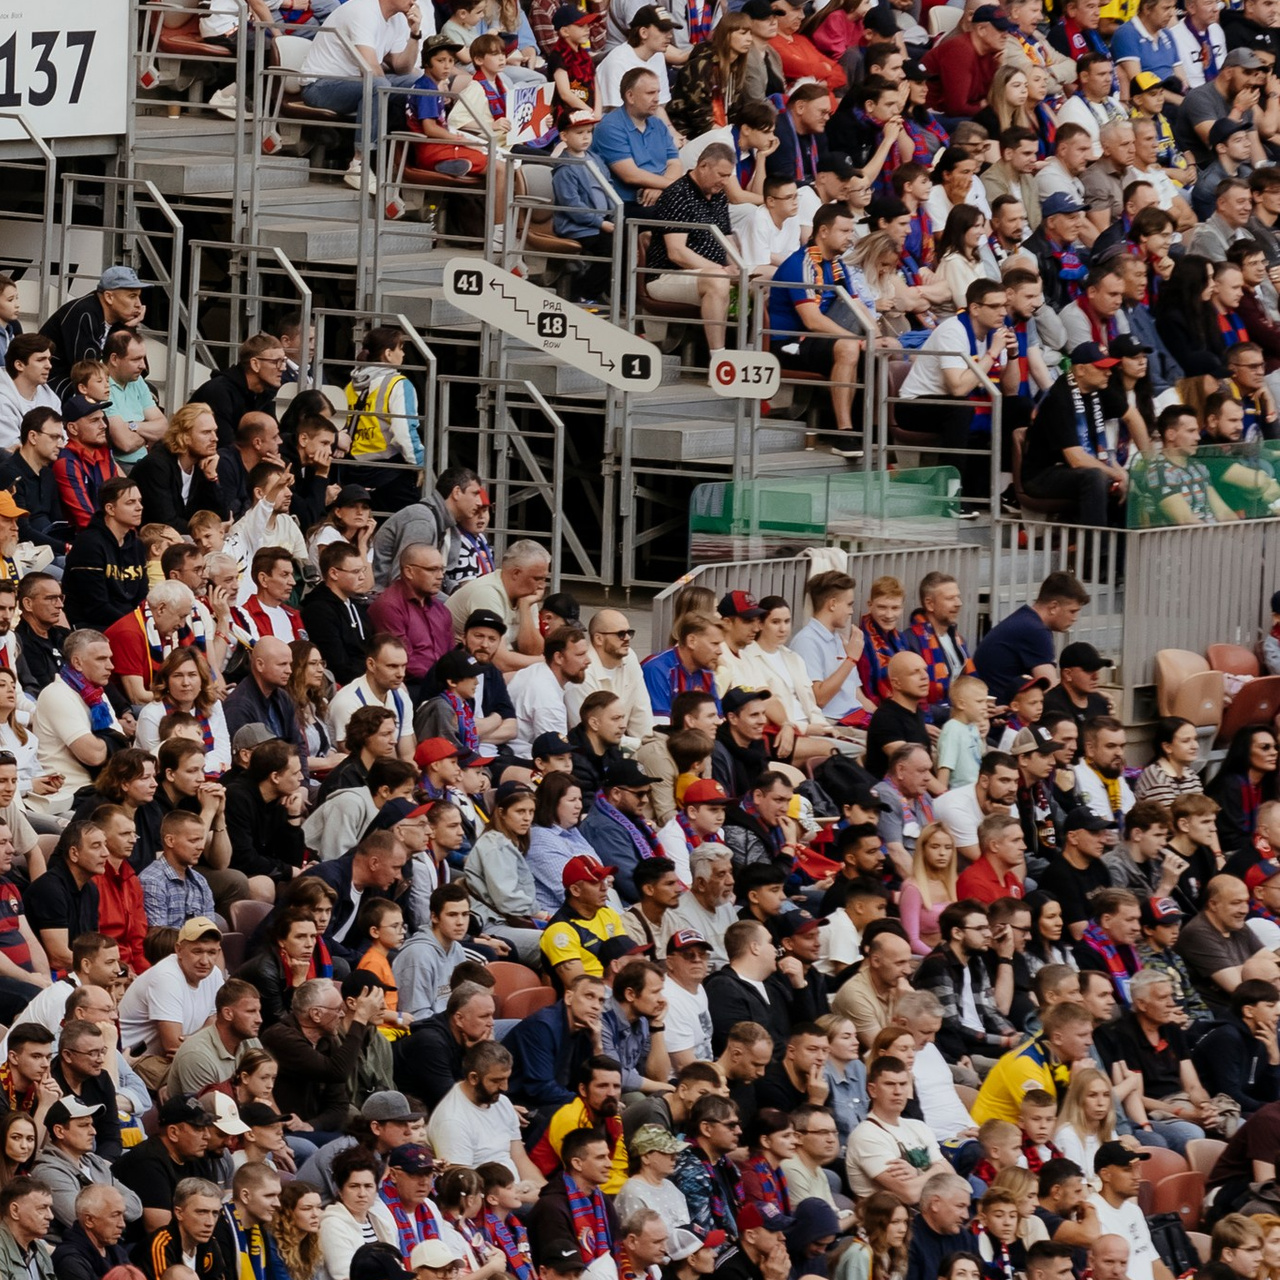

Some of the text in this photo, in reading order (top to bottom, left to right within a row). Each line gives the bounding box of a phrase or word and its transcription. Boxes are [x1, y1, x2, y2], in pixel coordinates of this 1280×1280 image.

[457, 274, 479, 292] 41
[542, 299, 563, 311] Ряд
[542, 316, 563, 334] 18
[542, 339, 562, 349] Row
[630, 358, 642, 375] 1
[720, 365, 775, 385] C 137
